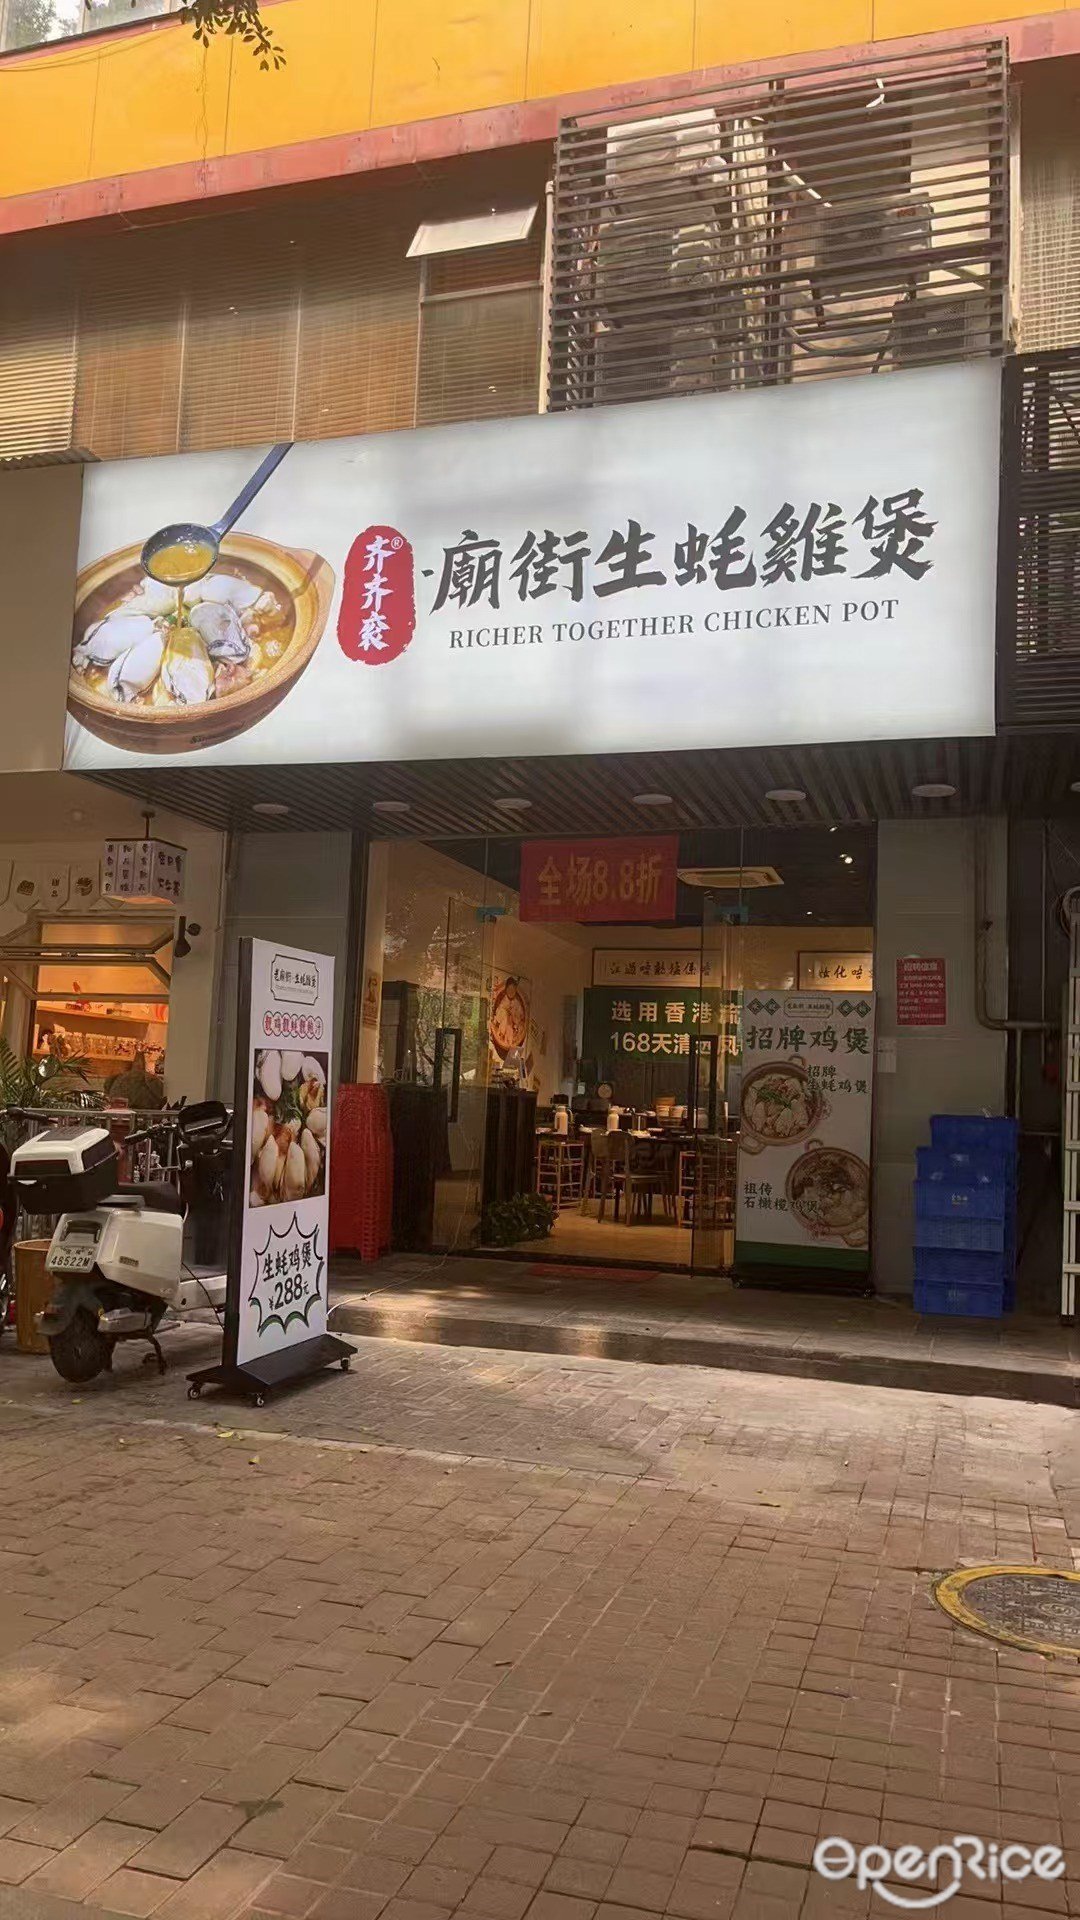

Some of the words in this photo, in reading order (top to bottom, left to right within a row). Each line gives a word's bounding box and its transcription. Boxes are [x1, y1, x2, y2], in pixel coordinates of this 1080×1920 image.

[449, 624, 543, 649] RICHER
[552, 613, 694, 643] TOGETHER
[704, 603, 832, 633] CHICKEN
[842, 599, 900, 623] POT
[537, 852, 663, 905] 全场8.8折
[746, 1025, 870, 1054] 招牌鸡煲
[744, 1181, 773, 1196] 祖传
[262, 1240, 312, 1282] 生蚝鸡煲
